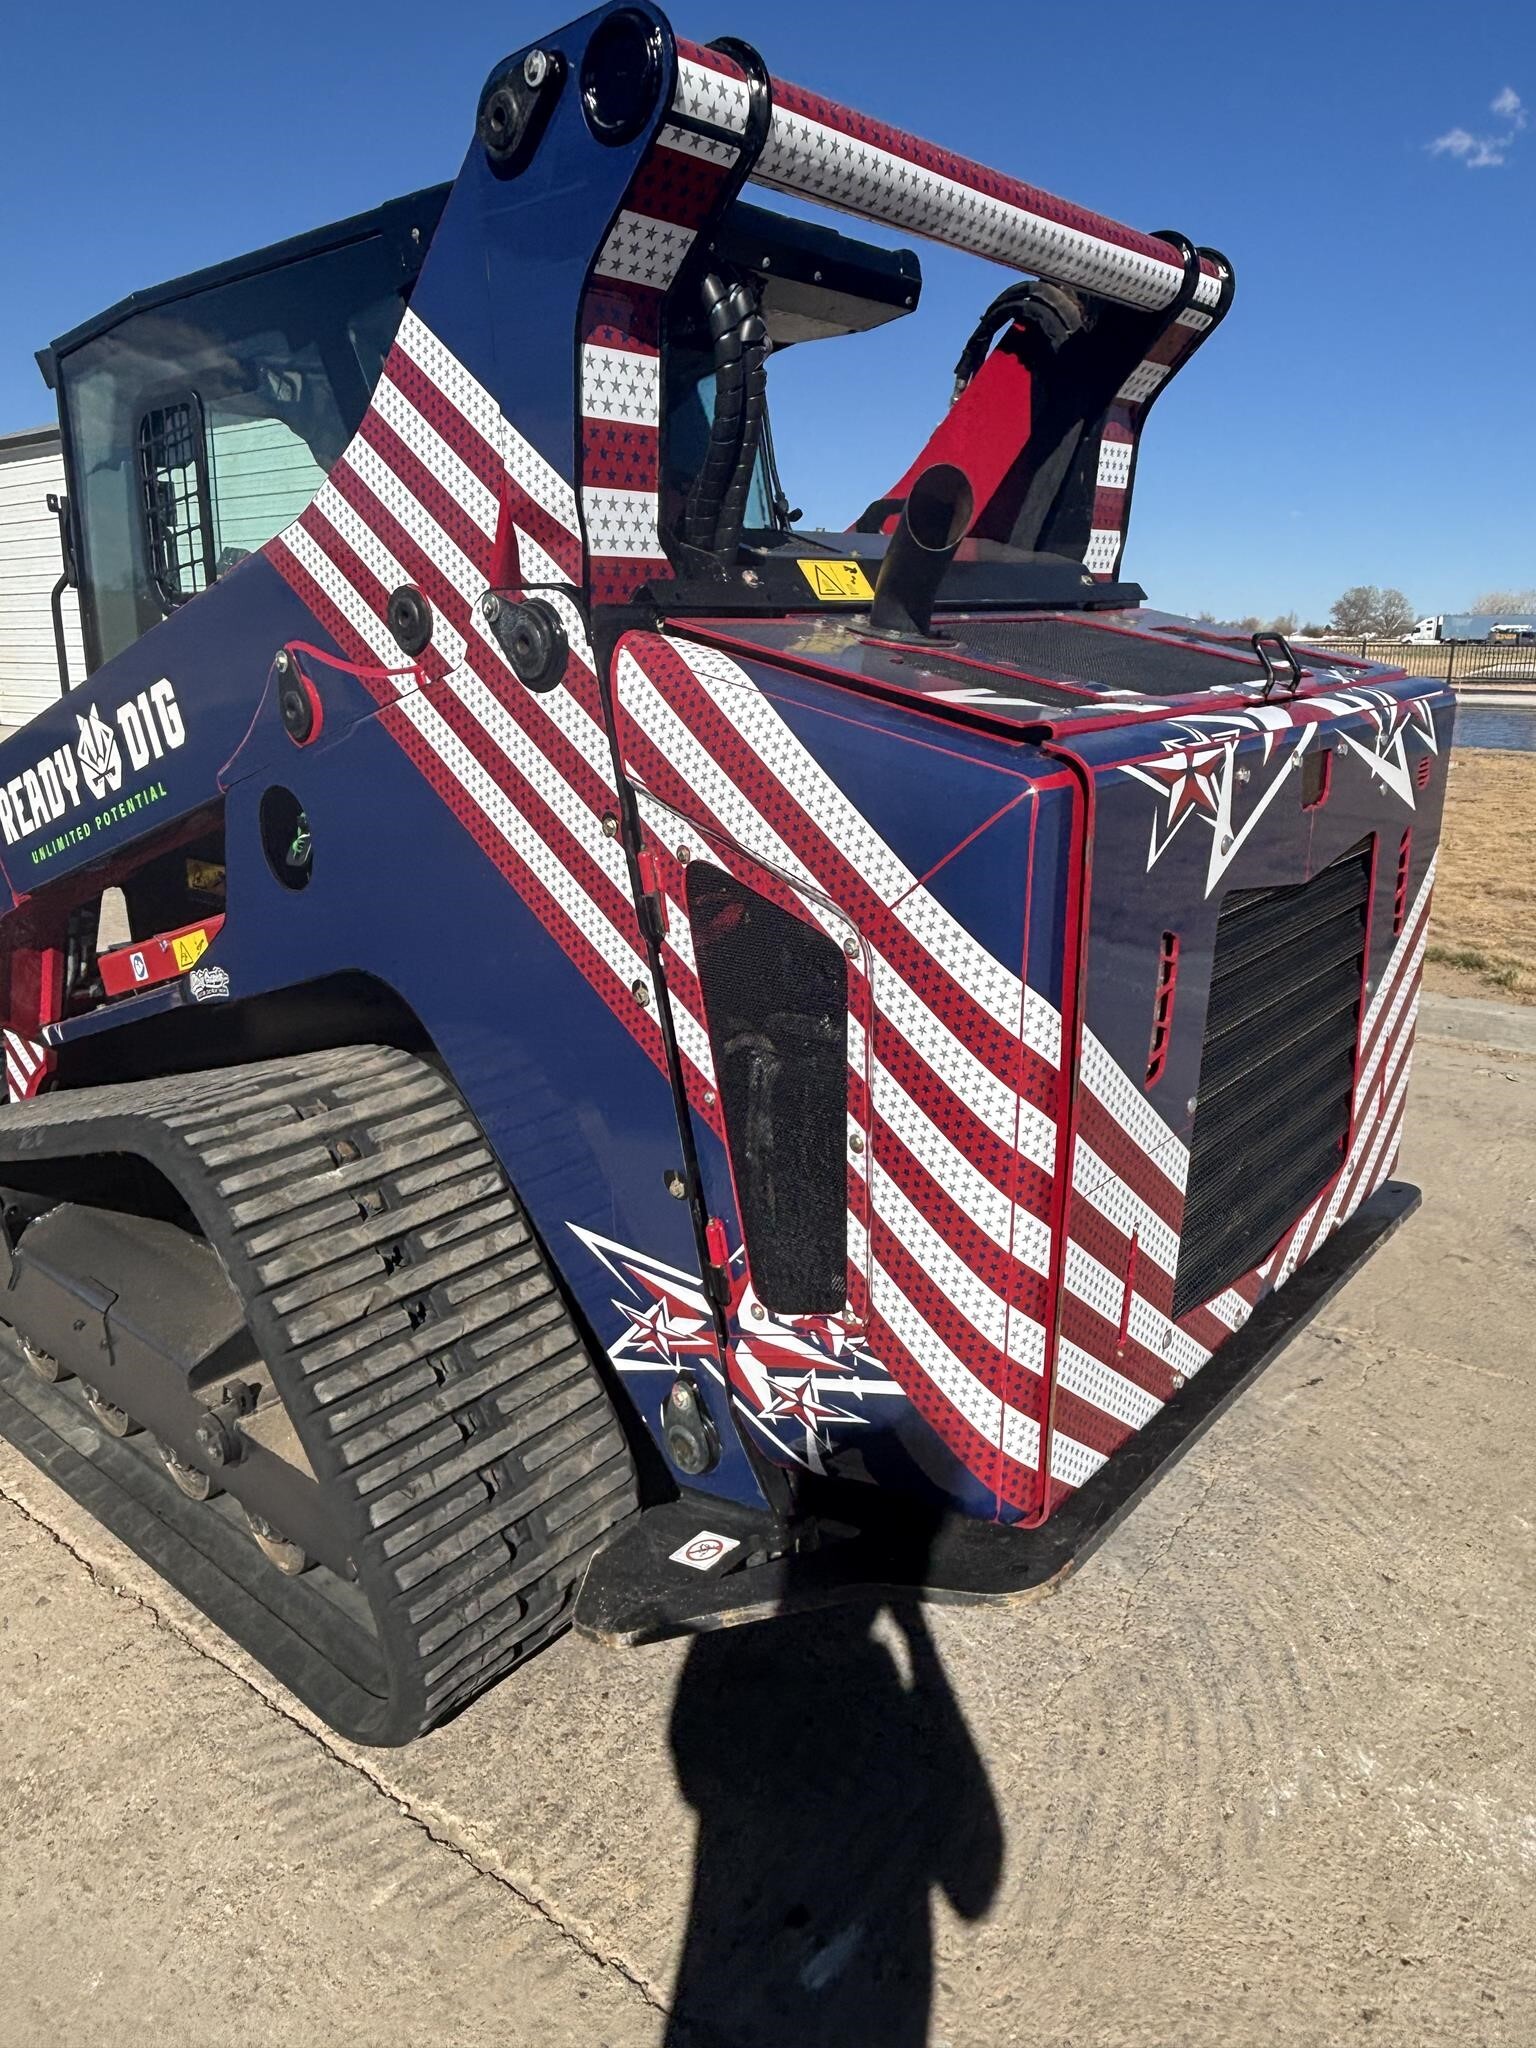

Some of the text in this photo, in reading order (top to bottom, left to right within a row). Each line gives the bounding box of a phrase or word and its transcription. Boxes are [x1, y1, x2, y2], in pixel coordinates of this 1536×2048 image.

[0, 678, 185, 845] READY DIG
[31, 782, 166, 864] UNLIMITED POTENTIAL
